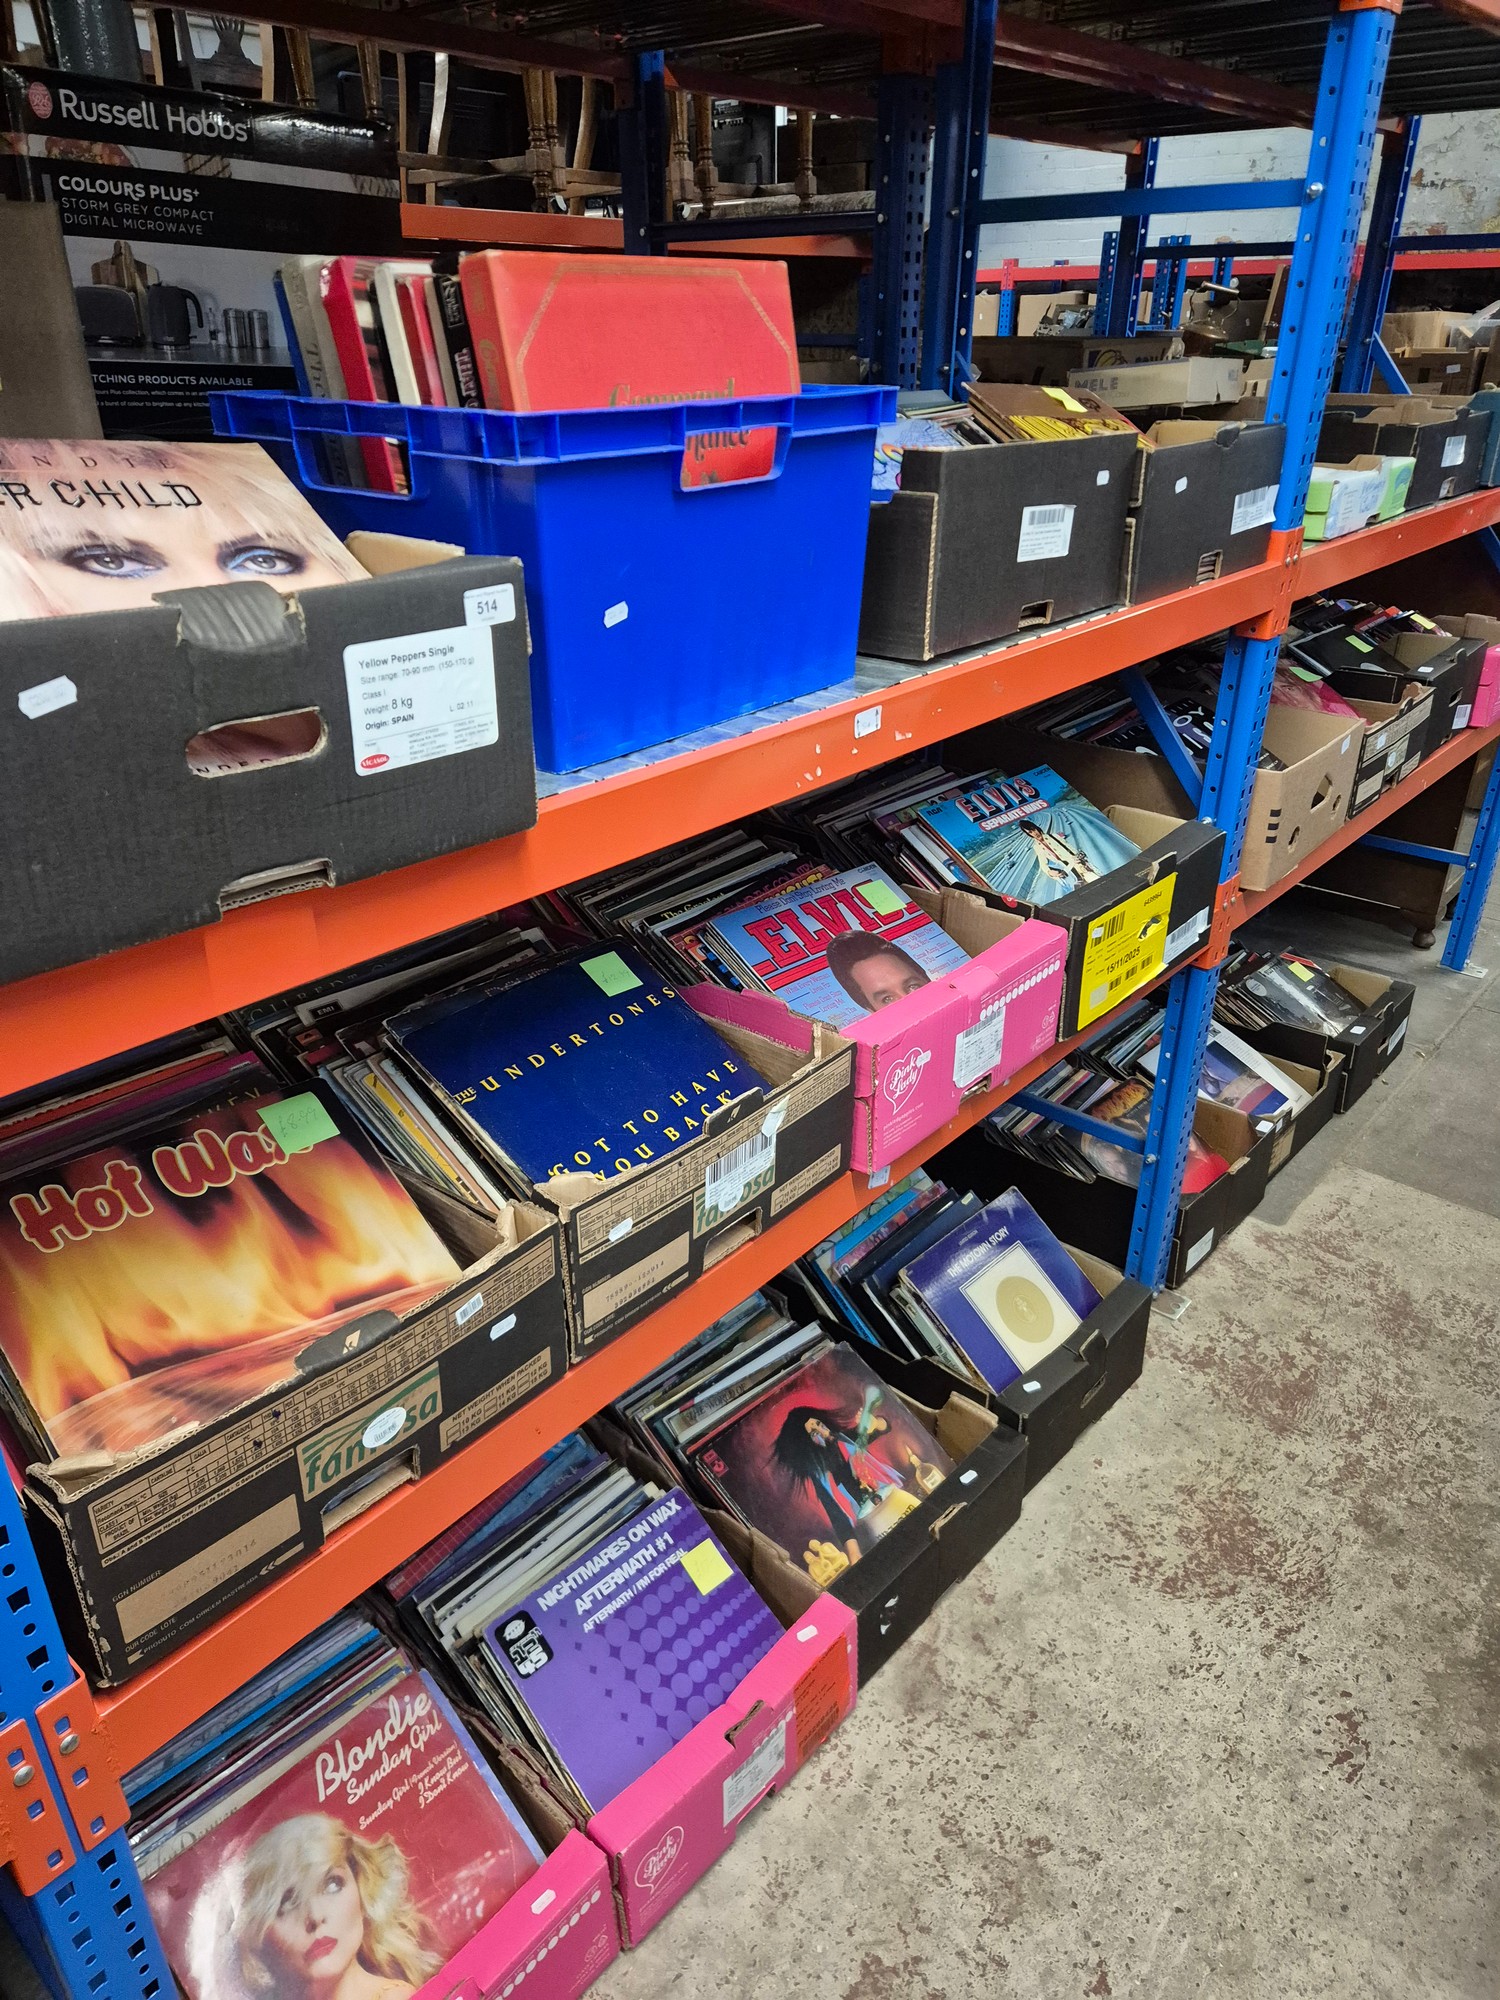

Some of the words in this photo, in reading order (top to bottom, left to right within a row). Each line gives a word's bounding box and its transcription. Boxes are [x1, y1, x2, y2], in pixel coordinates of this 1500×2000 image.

[59, 88, 159, 131] Russell
[165, 104, 249, 142] Hobbs
[58, 175, 146, 201] COLOURS
[61, 197, 109, 211] STORM
[114, 202, 149, 216] GREY
[153, 205, 215, 222] COMPACT
[64, 212, 118, 228] DIGITAL
[123, 218, 203, 236] MICROWAVE
[138, 375, 197, 385] PRODUCTS
[199, 376, 253, 386] AVAILABLE
[48, 478, 203, 510] CHILD
[477, 599, 498, 615] 514
[358, 656, 389, 670] Yellow
[391, 651, 426, 665] Peppers
[428, 645, 455, 658] Single
[361, 673, 376, 685] Size
[402, 666, 421, 677] 70-90
[422, 664, 435, 672] mm
[362, 691, 382, 701] Class
[391, 698, 399, 710] 8
[400, 696, 413, 710] kg
[365, 719, 390, 731] Origin:
[391, 713, 415, 725] SPAIN
[926, 807, 943, 817] RCA
[955, 777, 1039, 823] ELVIS
[981, 808, 1026, 832] SEPARATE
[1023, 799, 1049, 814] WAYS
[755, 899, 781, 915] Please
[799, 887, 814, 901] Stop
[811, 881, 834, 896] Loving
[834, 877, 847, 887] Me
[1106, 946, 1141, 975] 15/11/2025
[317, 1005, 335, 1017] EMI
[480, 986, 677, 1093] UNDERTONES
[889, 1053, 916, 1090] Pink
[893, 1068, 918, 1100] Lady
[454, 1086, 477, 1103] THE
[622, 1109, 659, 1135] TO
[670, 1060, 739, 1107] HAVE
[594, 1143, 655, 1181] YOU
[9, 1159, 154, 1253] Hot
[960, 1240, 992, 1270] MOTOWN
[988, 1225, 1010, 1246] STORY
[536, 1361, 548, 1374] KG
[537, 1370, 549, 1382] KG
[452, 1411, 466, 1423] NET
[467, 1395, 495, 1412] WEIGHT
[493, 1380, 516, 1399] WHEN
[515, 1355, 542, 1379] PACKED
[504, 1385, 517, 1397] KG
[504, 1393, 517, 1405] KG
[469, 1417, 482, 1429] KG
[470, 1408, 483, 1420] KG
[105, 1523, 127, 1539] PRODUCT
[536, 1536, 632, 1612] NIGHTMARES
[628, 1517, 654, 1543] ON
[648, 1497, 683, 1529] WAX
[574, 1544, 658, 1616] AFTERMATH
[654, 1532, 675, 1553] #1
[582, 1587, 636, 1634] AFTERMATH
[649, 1561, 669, 1583] FOR
[143, 1629, 177, 1654] PRODUTO
[179, 1617, 196, 1631] COM
[195, 1599, 222, 1620] ORIGEM
[125, 1640, 140, 1653] OUR
[140, 1629, 159, 1645] CODE
[315, 1692, 432, 1803] Blondie
[346, 1744, 412, 1805] Sunday
[410, 1708, 443, 1753] Girl
[424, 1766, 448, 1789] Know
[446, 1749, 463, 1771] But
[446, 1762, 470, 1785] Know
[358, 1797, 395, 1831] Sunday
[392, 1779, 411, 1802] Girl
